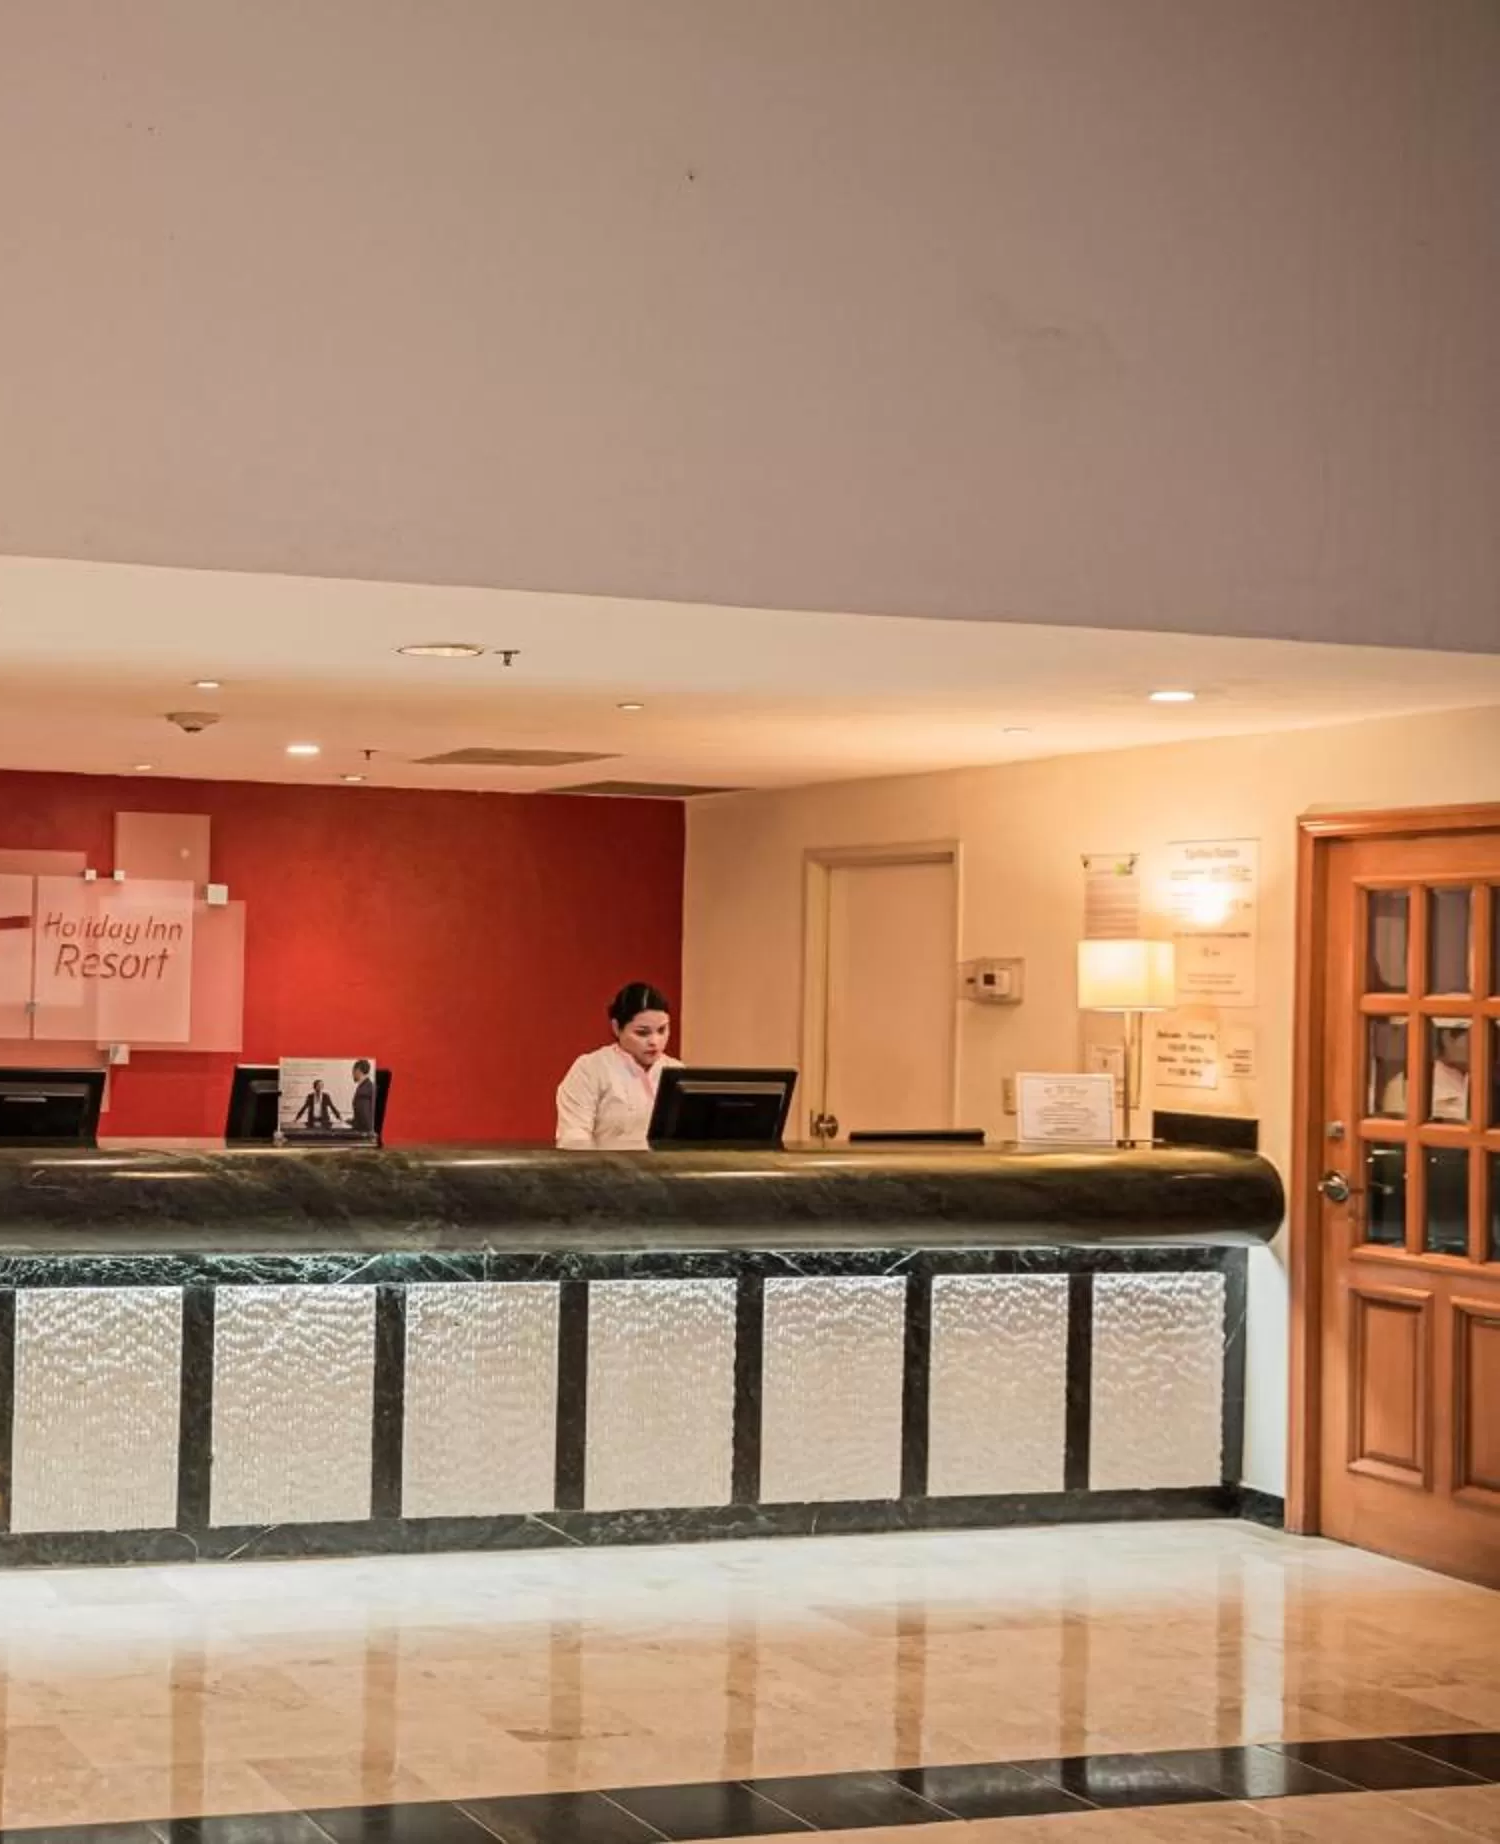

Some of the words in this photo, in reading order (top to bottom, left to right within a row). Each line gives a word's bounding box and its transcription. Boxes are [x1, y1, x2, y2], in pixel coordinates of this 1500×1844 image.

[43, 911, 140, 945] Holiday
[145, 915, 184, 941] Inn
[54, 943, 169, 979] Resort
